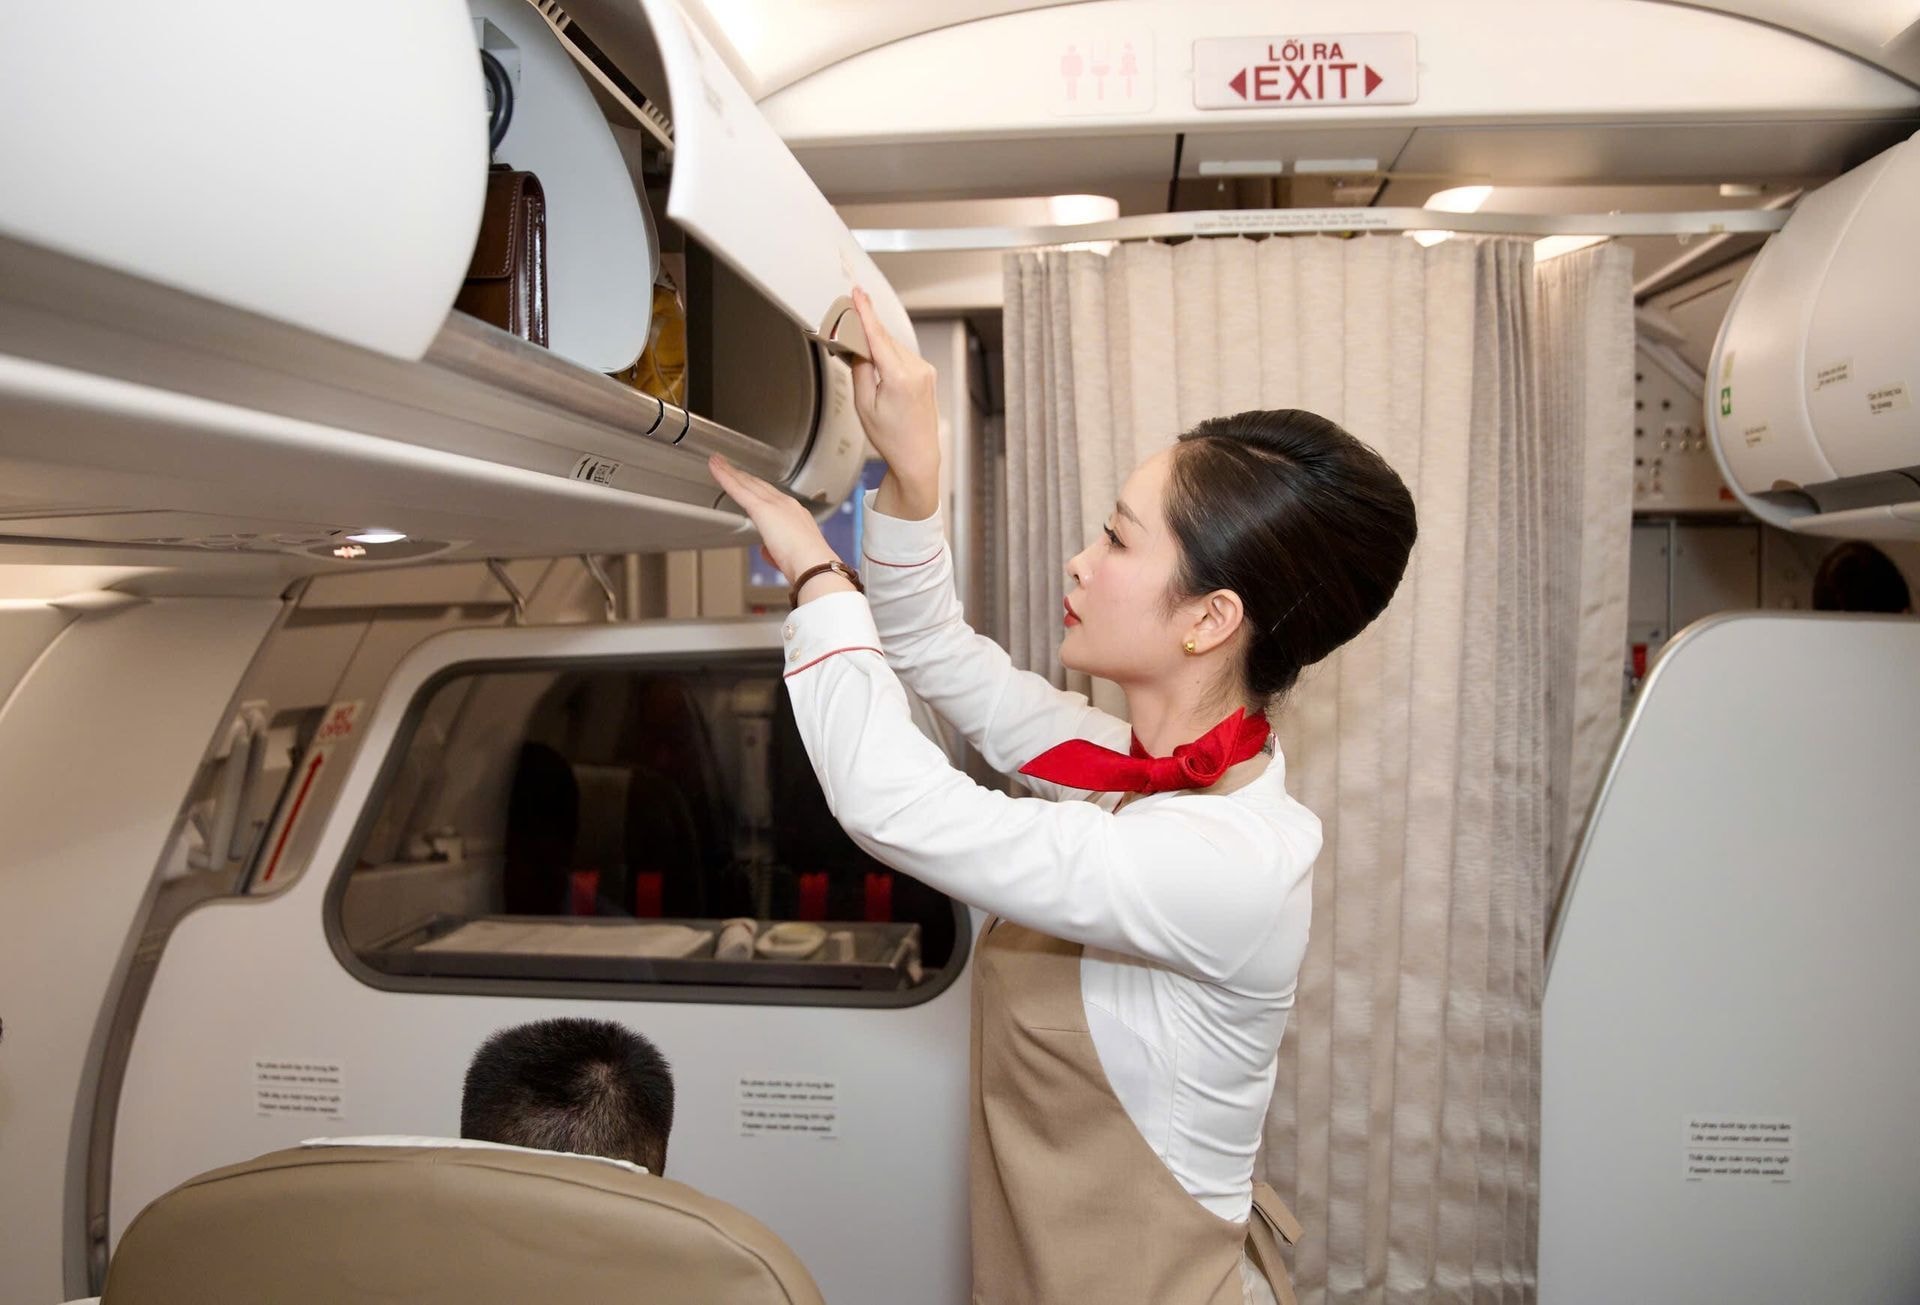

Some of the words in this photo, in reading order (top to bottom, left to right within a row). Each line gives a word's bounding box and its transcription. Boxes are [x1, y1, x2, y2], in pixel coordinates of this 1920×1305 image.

[1269, 39, 1304, 62] LỐI
[1313, 43, 1344, 60] RA
[1254, 63, 1358, 101] EXIT
